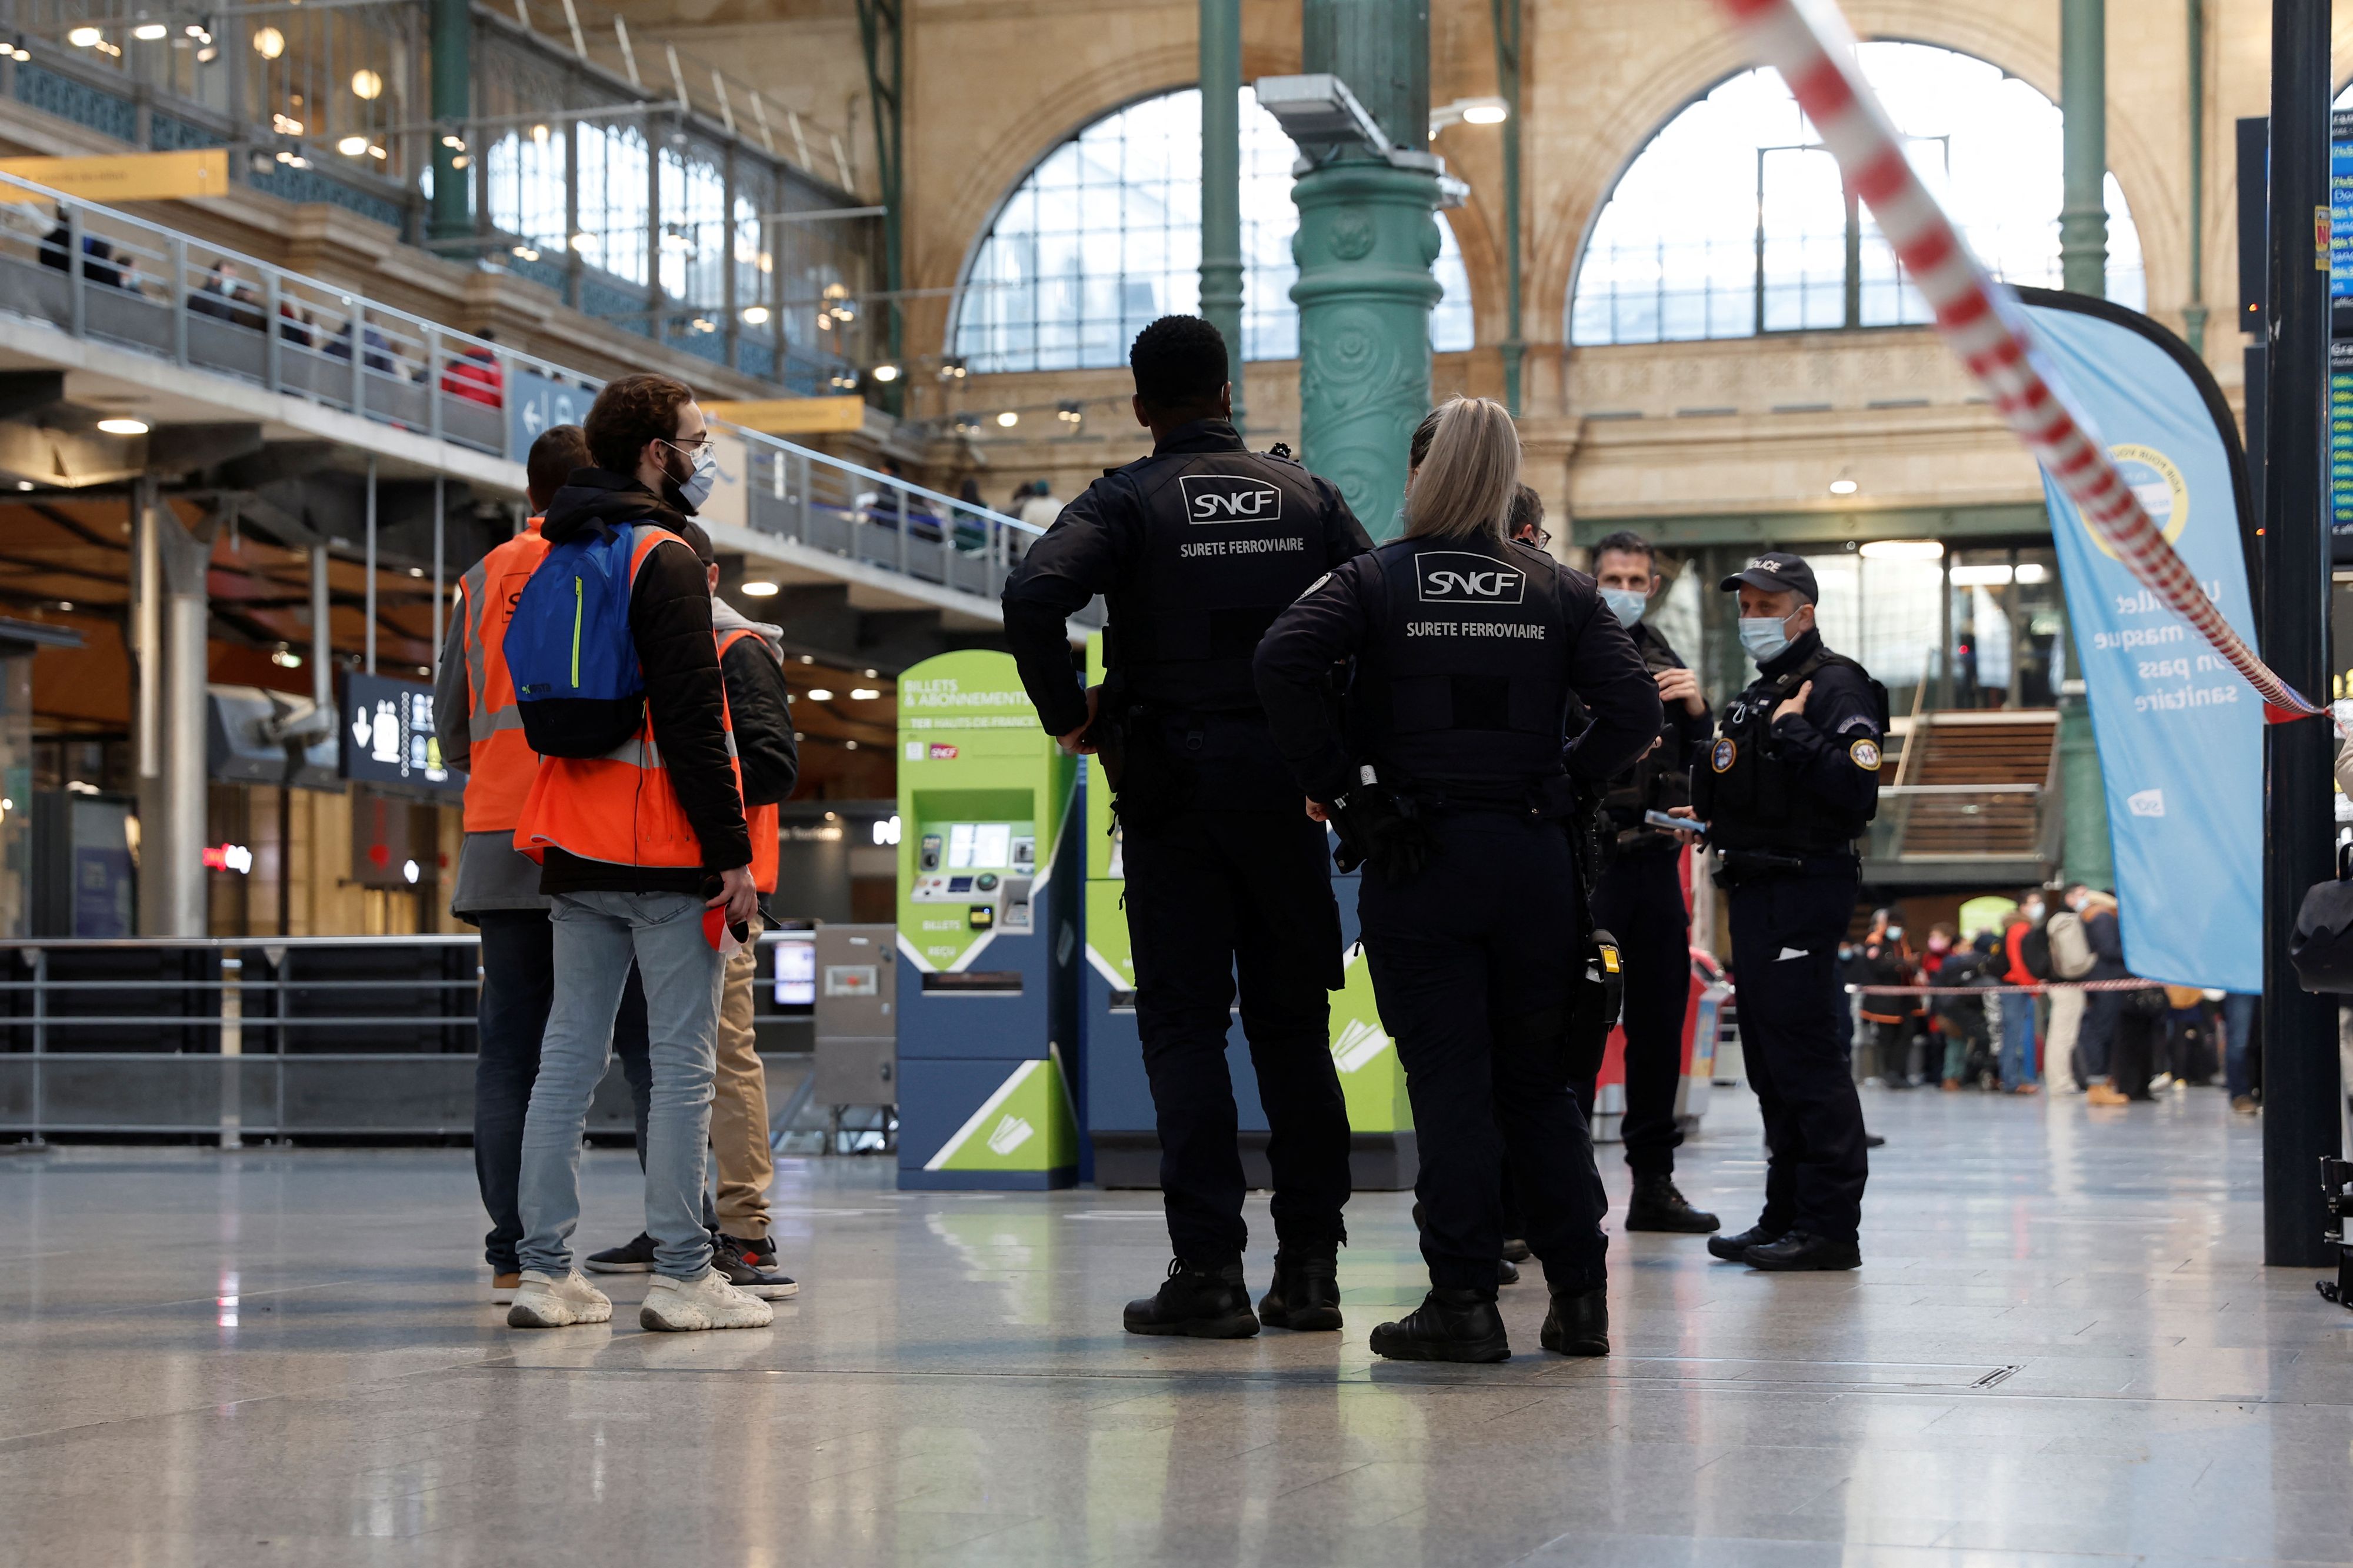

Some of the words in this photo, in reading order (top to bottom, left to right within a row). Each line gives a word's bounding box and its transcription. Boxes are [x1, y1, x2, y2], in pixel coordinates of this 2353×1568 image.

[1193, 491, 1275, 517] SNCF
[1181, 542, 1227, 558] SURETE
[1229, 538, 1304, 554] FERROVIAIRE
[1425, 571, 1519, 596] SNCF
[1407, 622, 1458, 637] SURETE
[1461, 622, 1545, 640] FERROVIAIRE
[904, 679, 959, 693] BILLETS
[918, 691, 1031, 707] ABONNEMENTS
[931, 748, 958, 758] SNCF
